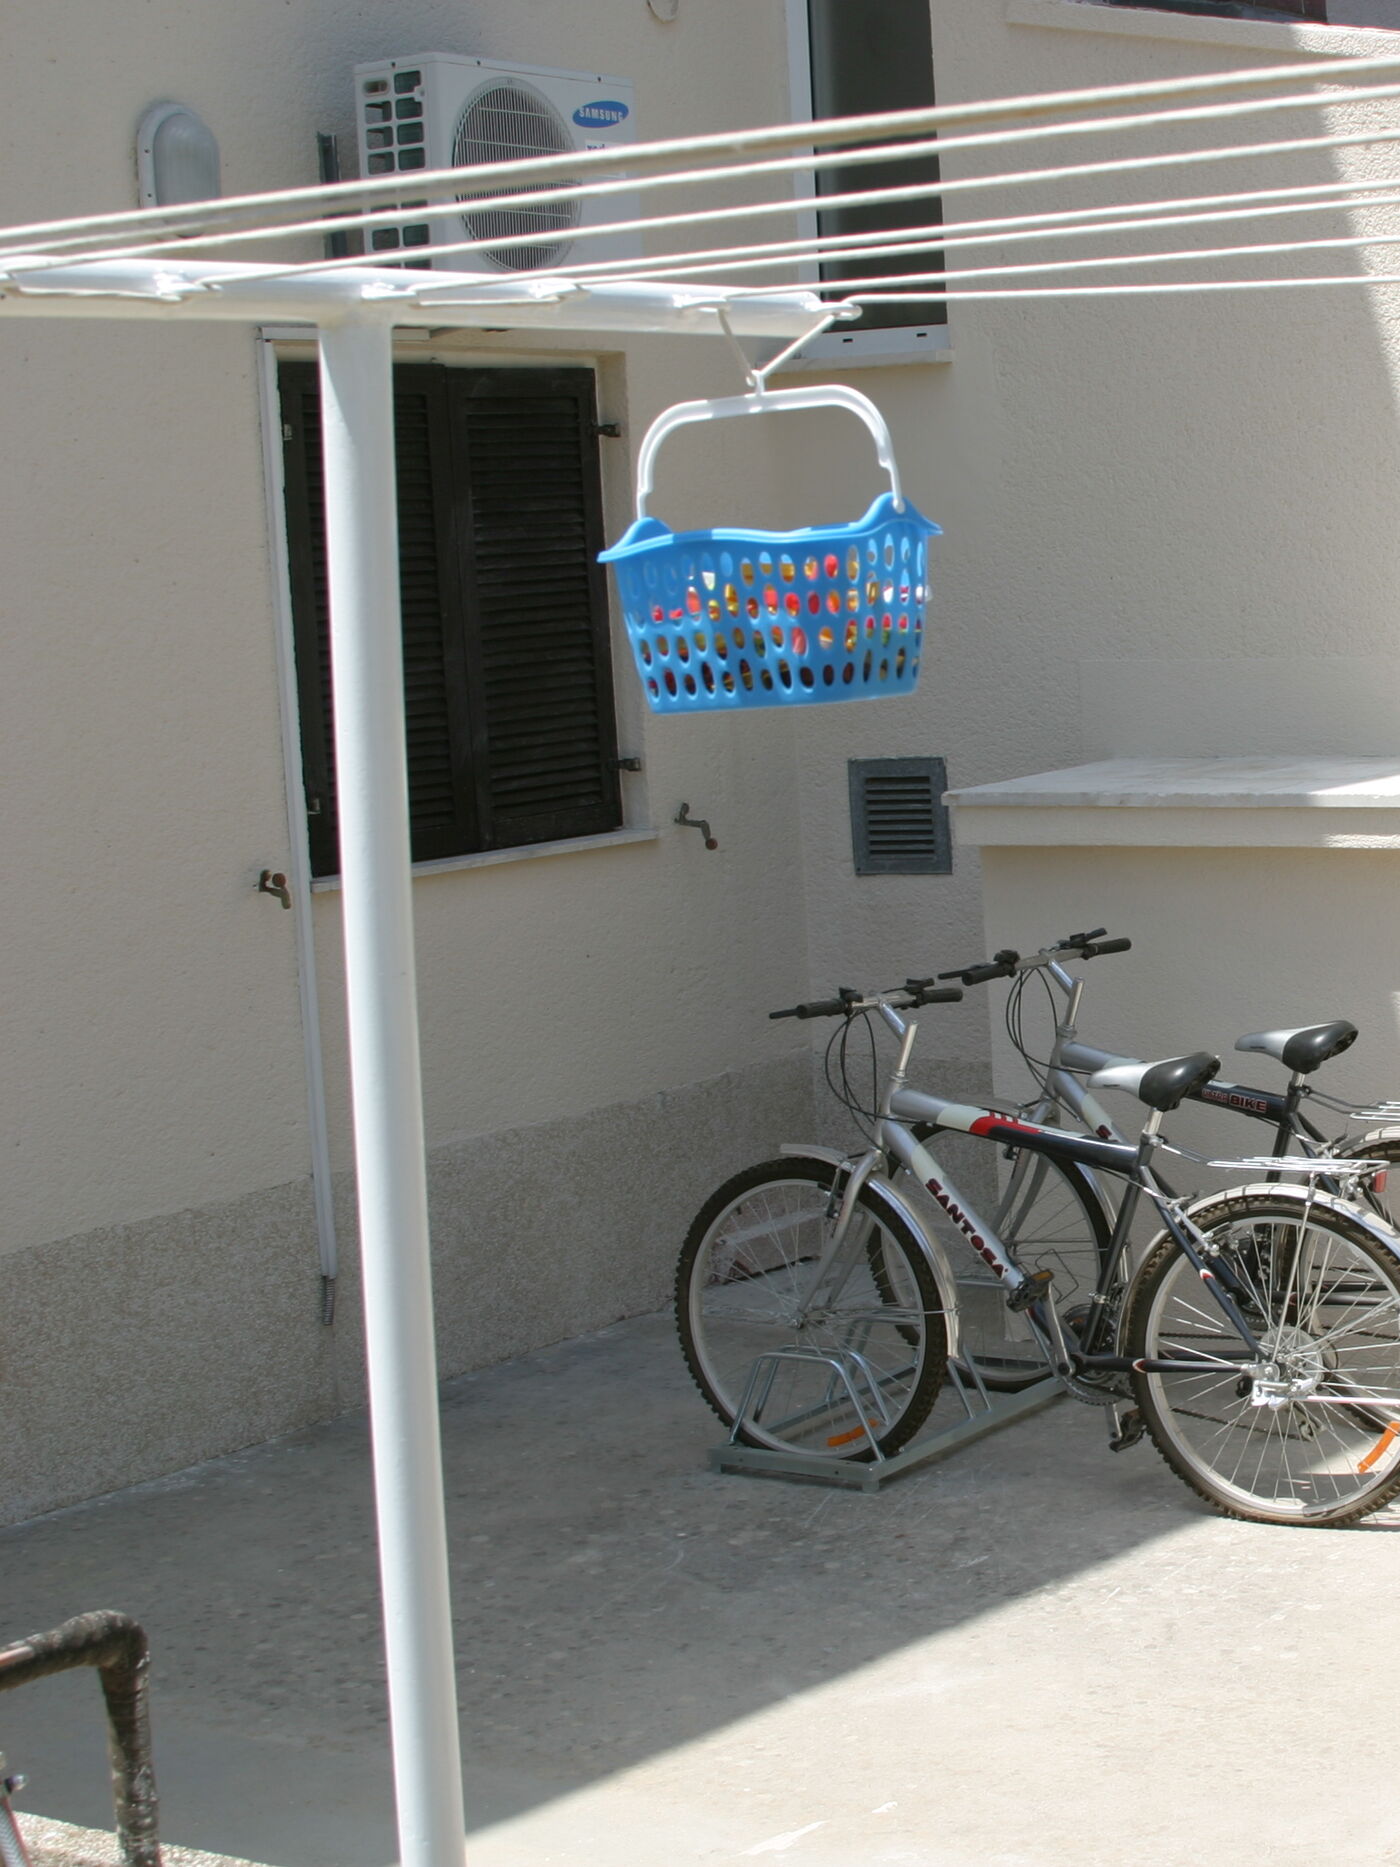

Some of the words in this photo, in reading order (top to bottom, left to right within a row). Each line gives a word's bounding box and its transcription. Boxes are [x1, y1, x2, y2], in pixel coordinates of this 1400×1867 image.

[578, 106, 624, 122] SAMSUNG
[1229, 1092, 1268, 1113] BIKE
[924, 1178, 1005, 1279] SANTOSA
